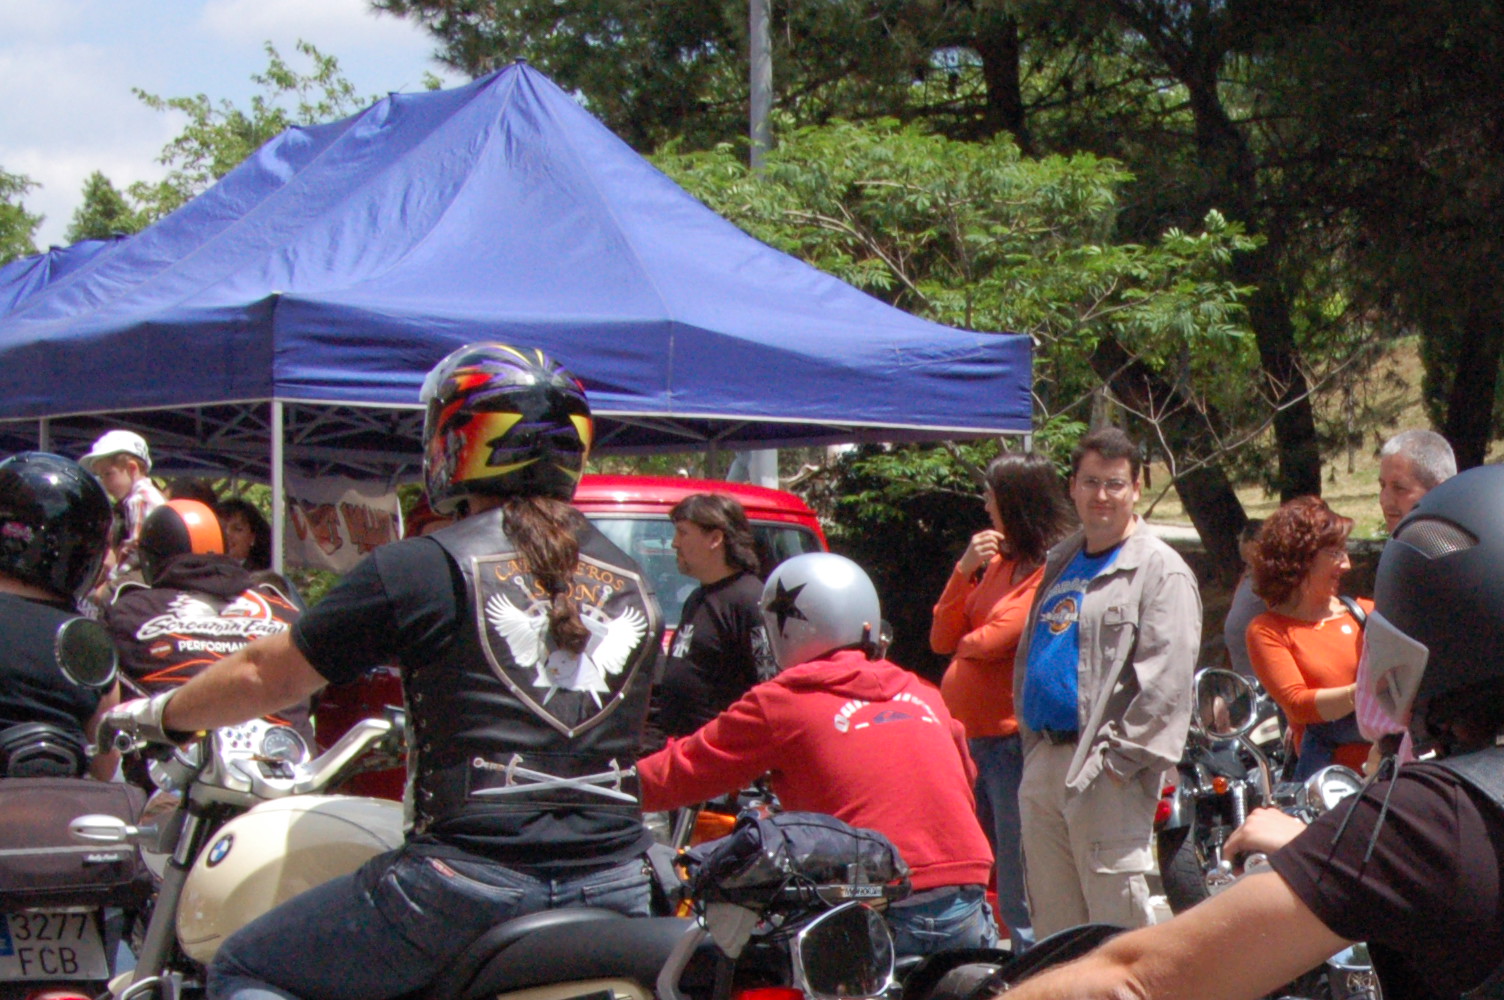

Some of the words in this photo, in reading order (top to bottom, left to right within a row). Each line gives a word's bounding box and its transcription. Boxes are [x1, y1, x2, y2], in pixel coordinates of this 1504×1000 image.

[495, 559, 624, 591] CAEROS
[243, 619, 286, 635] Eagl
[178, 640, 250, 653] PERFORMAN
[11, 913, 87, 941] 3277
[18, 947, 79, 976] FCB
